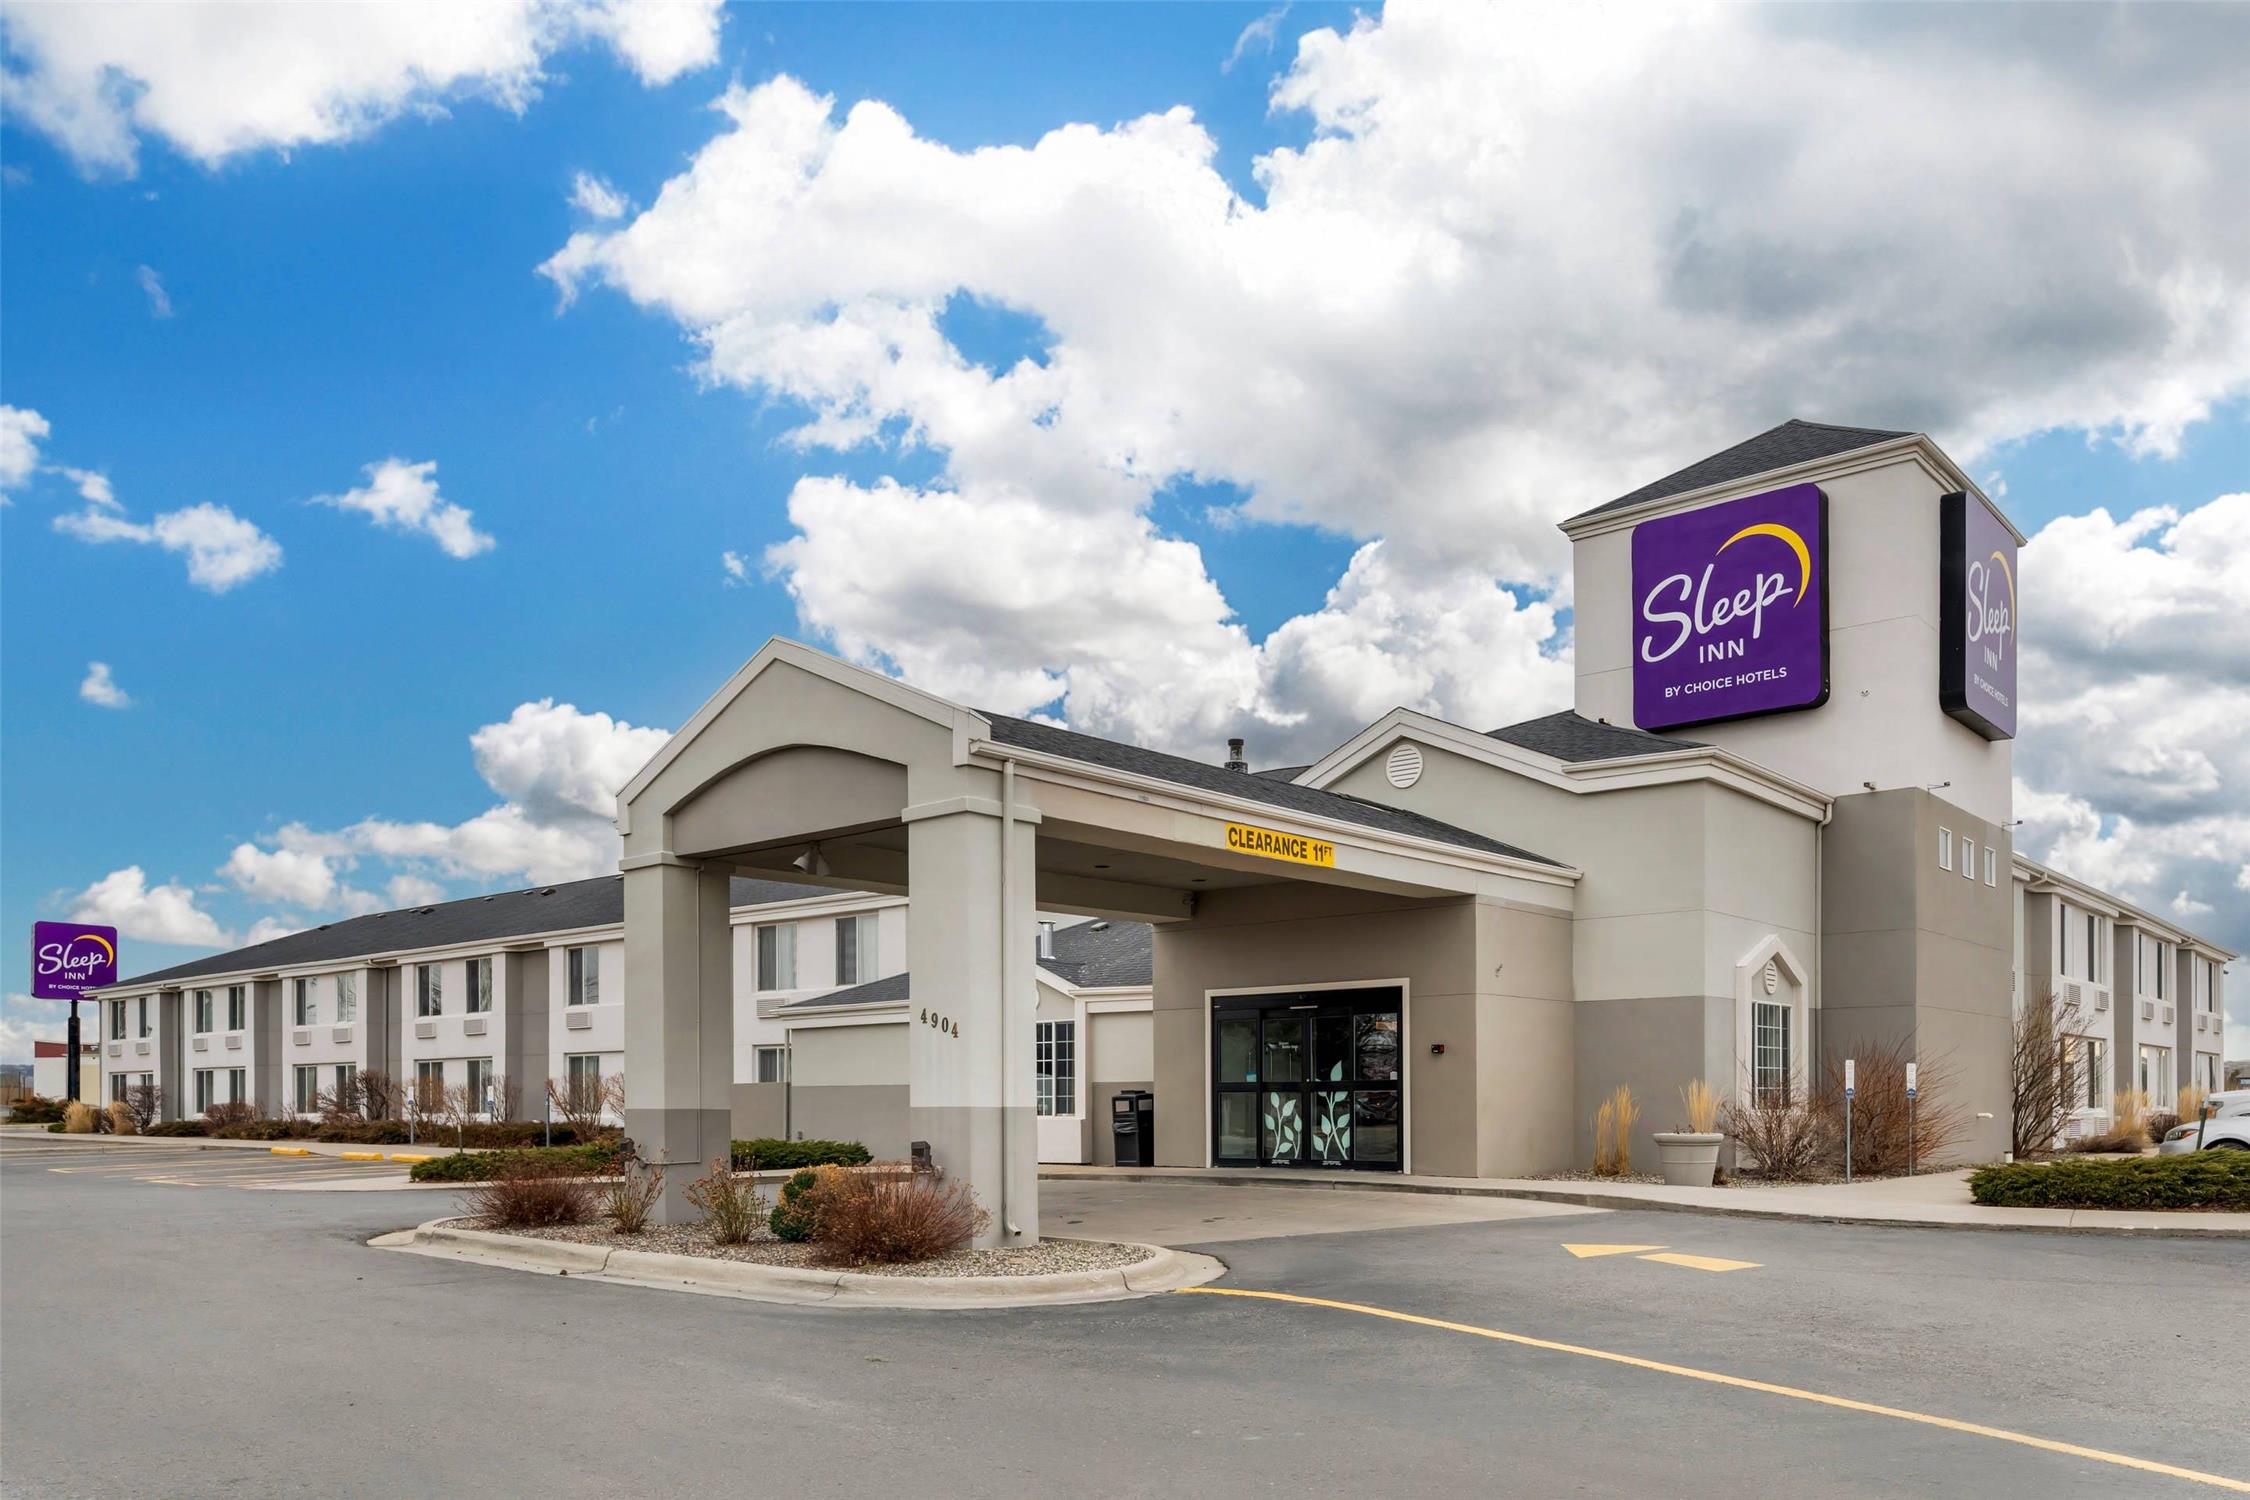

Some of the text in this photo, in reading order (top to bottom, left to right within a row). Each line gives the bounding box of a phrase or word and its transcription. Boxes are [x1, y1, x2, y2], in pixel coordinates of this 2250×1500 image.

[1641, 563, 1793, 663] Sleep
[1967, 561, 2010, 660] Sleep
[1699, 638, 1744, 663] INN
[1984, 645, 1998, 672] INN
[1665, 667, 1788, 698] BY CHOICE HOTELS
[1980, 678, 1994, 697] CHOICE
[1995, 689, 2008, 707] HOTELS
[1228, 827, 1307, 859] CLEARANCE
[38, 943, 106, 976] Sleep
[64, 972, 85, 980] INN
[920, 1008, 959, 1039] 4904
